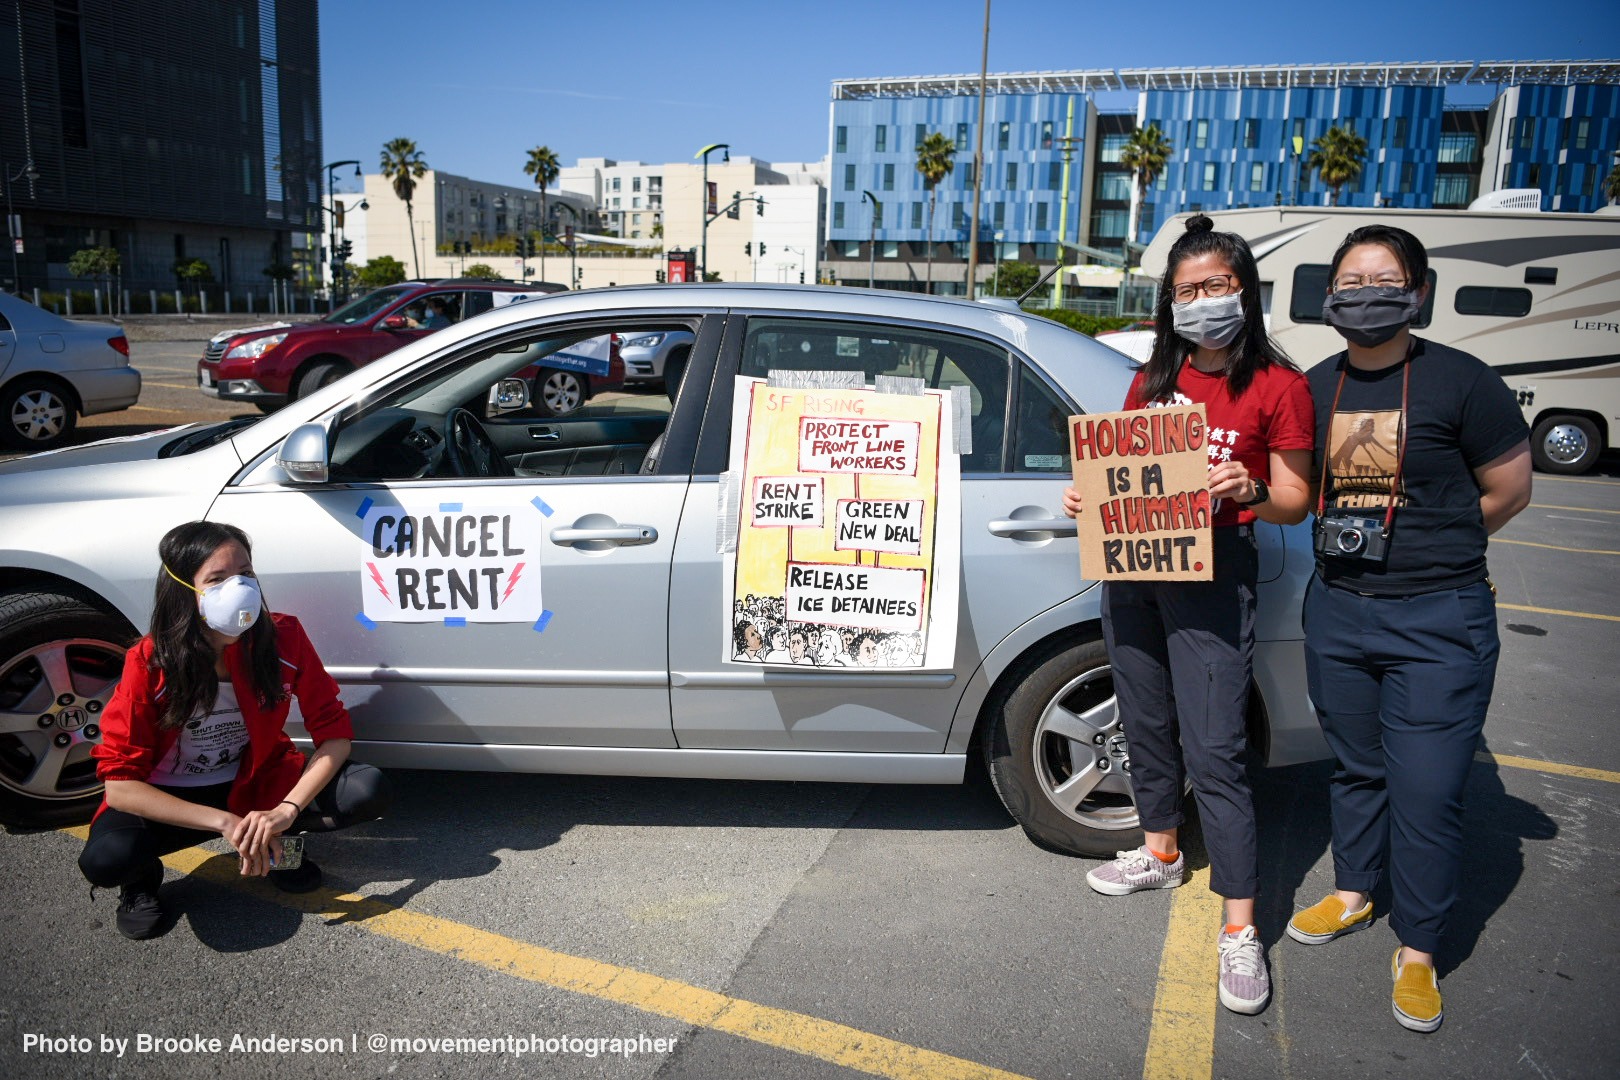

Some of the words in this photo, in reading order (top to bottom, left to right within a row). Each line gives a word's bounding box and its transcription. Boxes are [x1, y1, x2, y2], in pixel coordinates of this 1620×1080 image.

[1574, 320, 1620, 333] LEPR
[766, 393, 793, 412] SF
[802, 395, 866, 416] RISING
[805, 422, 890, 441] PROTECT
[1073, 412, 1205, 461] HOUSING
[1206, 427, 1240, 445] 教育
[812, 440, 859, 456] FRONT
[866, 439, 905, 453] LINE
[830, 456, 906, 470] WORKERS
[1106, 466, 1131, 496] IS
[1141, 463, 1164, 496] A
[761, 483, 816, 500] RENT
[755, 502, 814, 519] STRIKE
[846, 501, 910, 519] GREEN
[1099, 488, 1210, 535] HUMAN
[372, 514, 525, 558] CANCEL
[839, 521, 877, 541] NEW
[885, 524, 919, 543] DEAL
[1103, 536, 1204, 574] RIGHT.
[395, 567, 504, 610] RENT
[790, 567, 868, 591] RELEASE
[798, 597, 823, 612] ICE
[832, 597, 917, 617] DETAINEES
[191, 725, 213, 735] SHUT
[214, 720, 241, 729] DOWN
